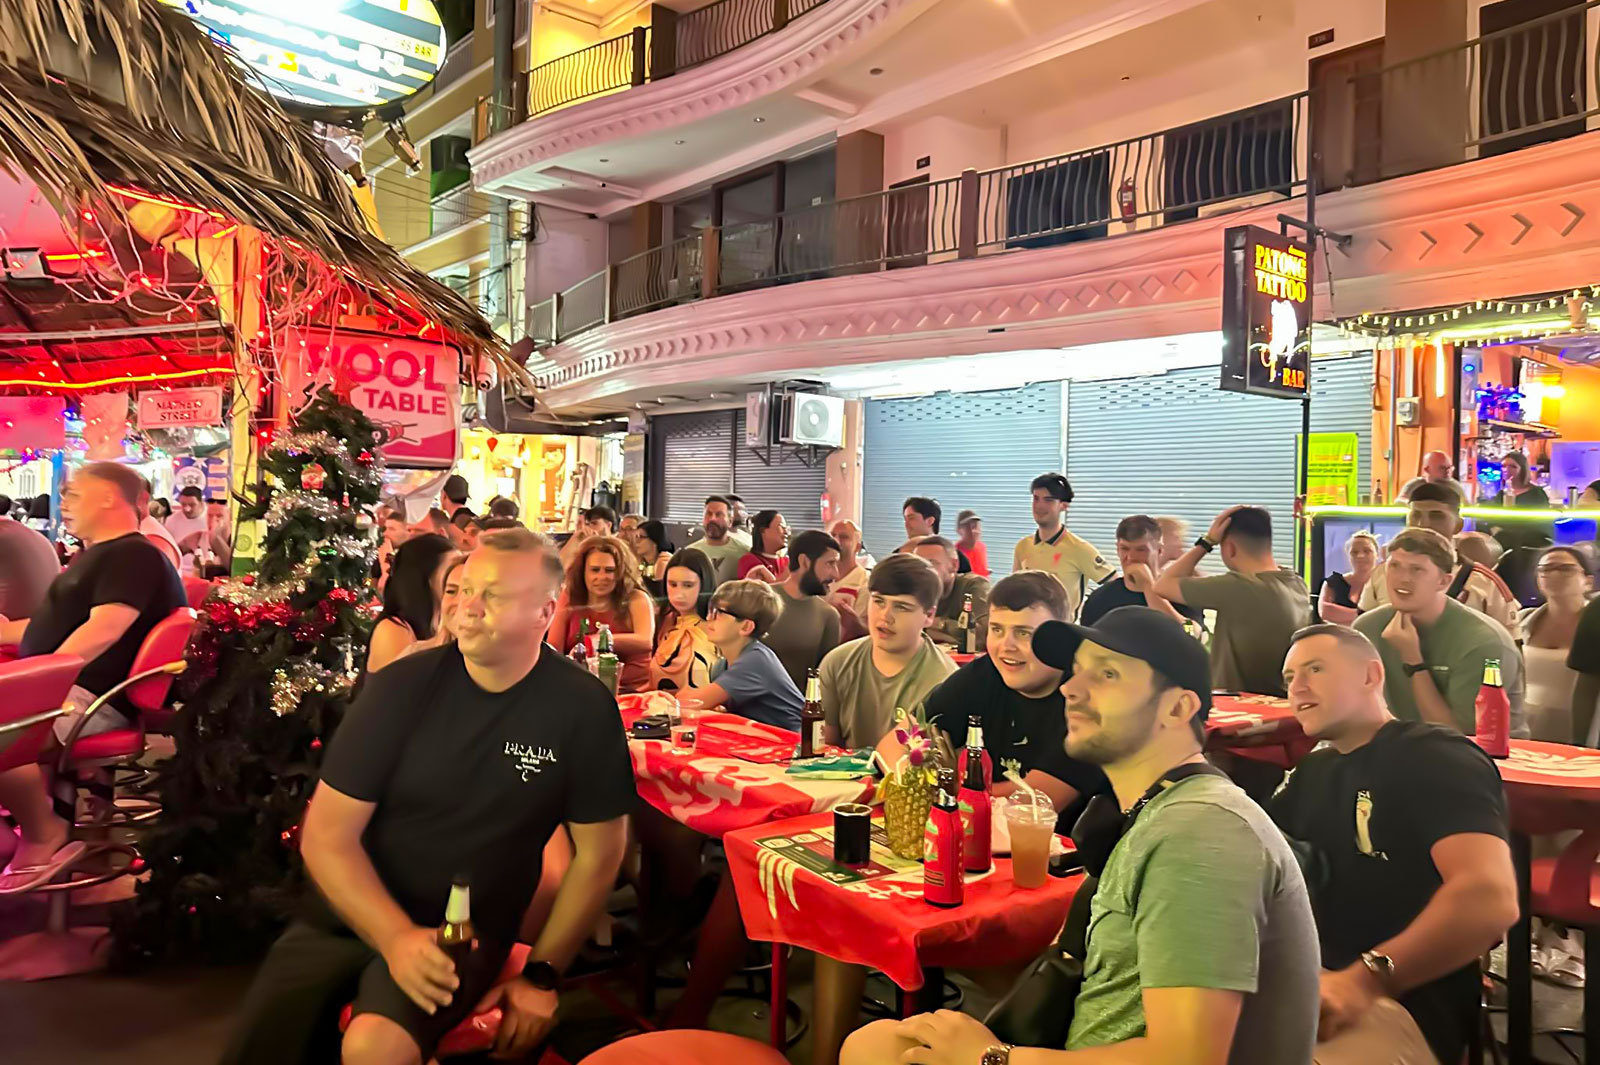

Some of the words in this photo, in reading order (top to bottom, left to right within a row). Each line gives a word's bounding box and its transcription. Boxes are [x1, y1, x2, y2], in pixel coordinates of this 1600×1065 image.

[1255, 244, 1307, 280] PATONG
[1255, 269, 1307, 303] TATTOO
[308, 343, 446, 392] POOL
[1282, 367, 1305, 389] BAR
[160, 410, 198, 421] STREET
[363, 387, 447, 416] TABLE
